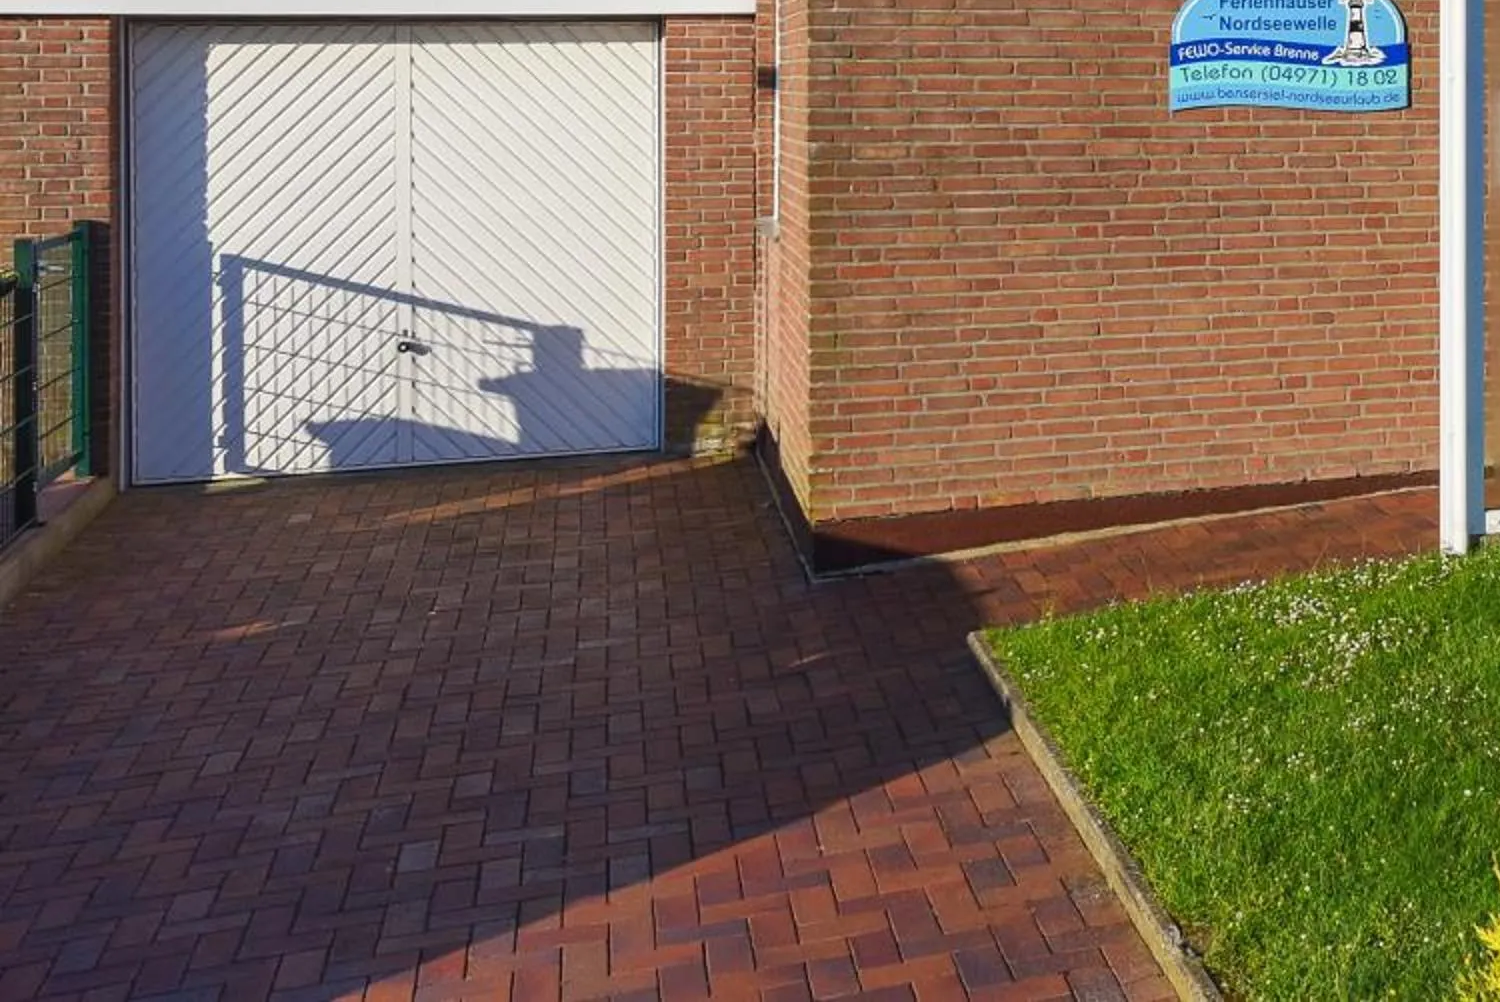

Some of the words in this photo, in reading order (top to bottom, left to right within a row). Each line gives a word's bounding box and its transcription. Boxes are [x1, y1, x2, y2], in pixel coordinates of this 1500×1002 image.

[1219, 15, 1337, 32] Nordseewelle
[1179, 64, 1253, 83] Telefon
[1261, 65, 1338, 88] (04971)
[1347, 70, 1369, 86] 18
[1374, 69, 1397, 85] 02
